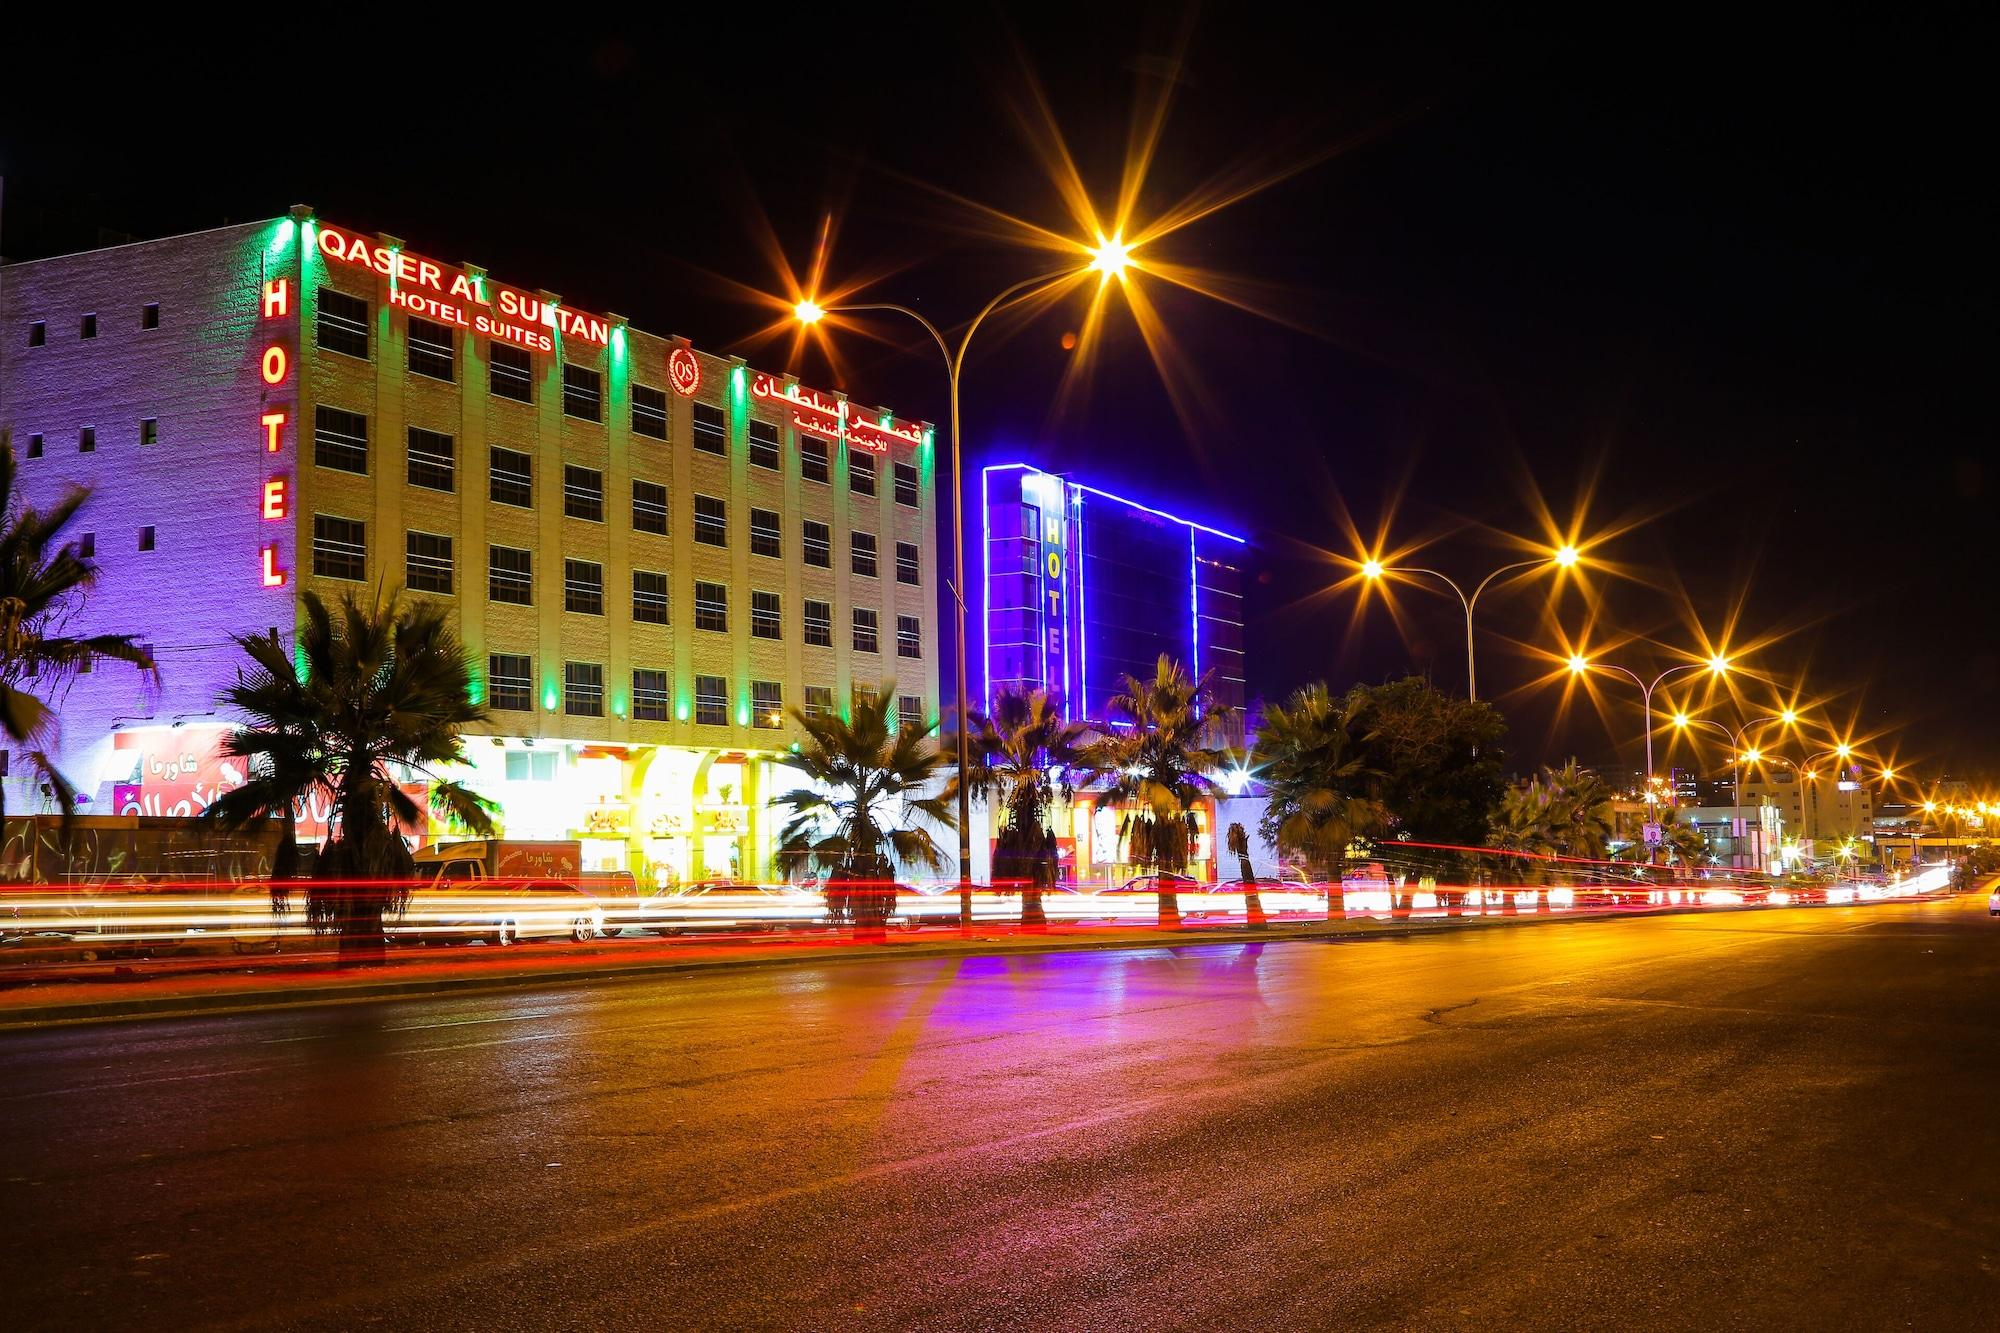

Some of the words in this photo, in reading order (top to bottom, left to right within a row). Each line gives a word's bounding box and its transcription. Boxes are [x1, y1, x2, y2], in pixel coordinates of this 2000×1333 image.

[318, 229, 441, 290] QASER
[450, 274, 491, 307] AL
[499, 290, 609, 345] SULTAN
[390, 288, 469, 326] HOTEL
[475, 315, 551, 352] SUITES
[674, 360, 693, 383] QS
[261, 278, 288, 588] HOTEL
[1046, 516, 1061, 693] HOTEL
[149, 753, 198, 781] شاورما
